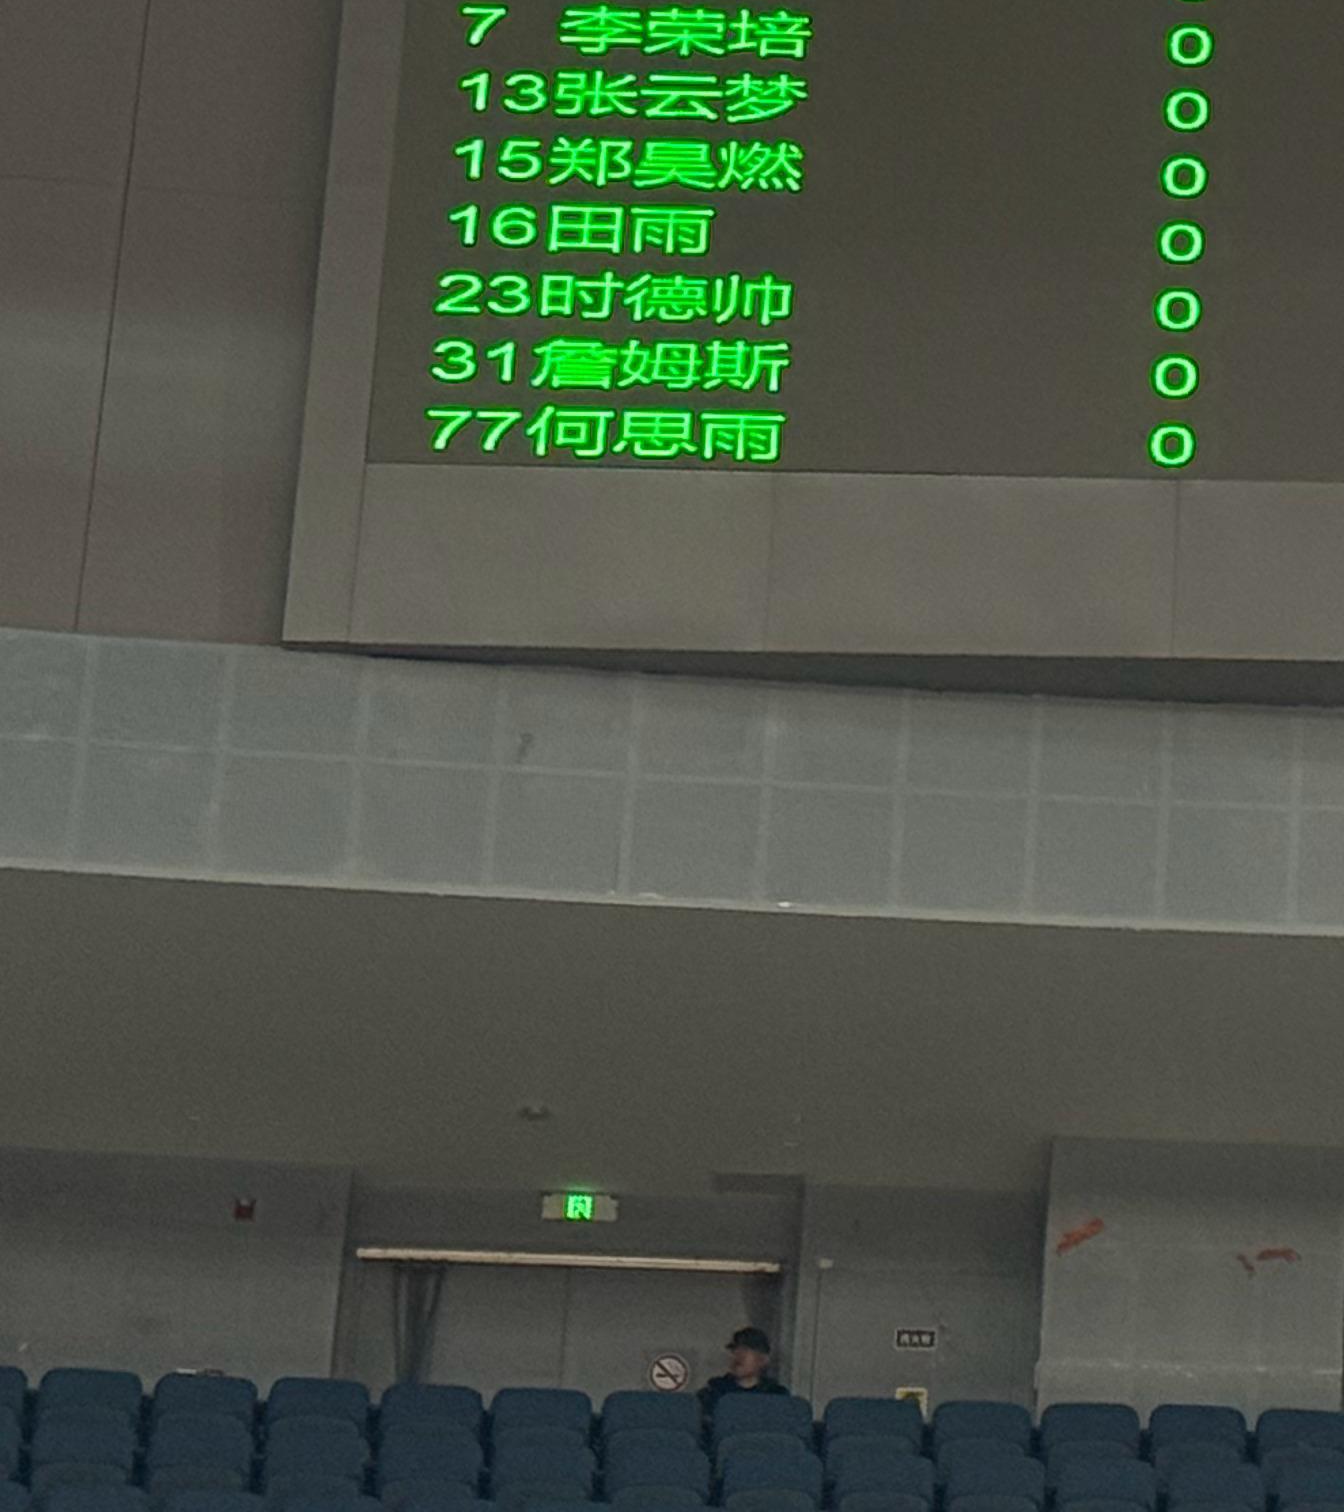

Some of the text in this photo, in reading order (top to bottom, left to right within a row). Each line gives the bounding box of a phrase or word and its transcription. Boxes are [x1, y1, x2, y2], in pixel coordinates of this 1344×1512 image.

[460, 3, 812, 57] 7 李荣培
[1166, 24, 1213, 65] 0
[1164, 88, 1209, 130] 0
[1161, 156, 1207, 197] 0
[1158, 220, 1203, 262] 0
[1154, 288, 1201, 331] 0
[1150, 354, 1197, 398] 0
[1148, 422, 1195, 467] 0
